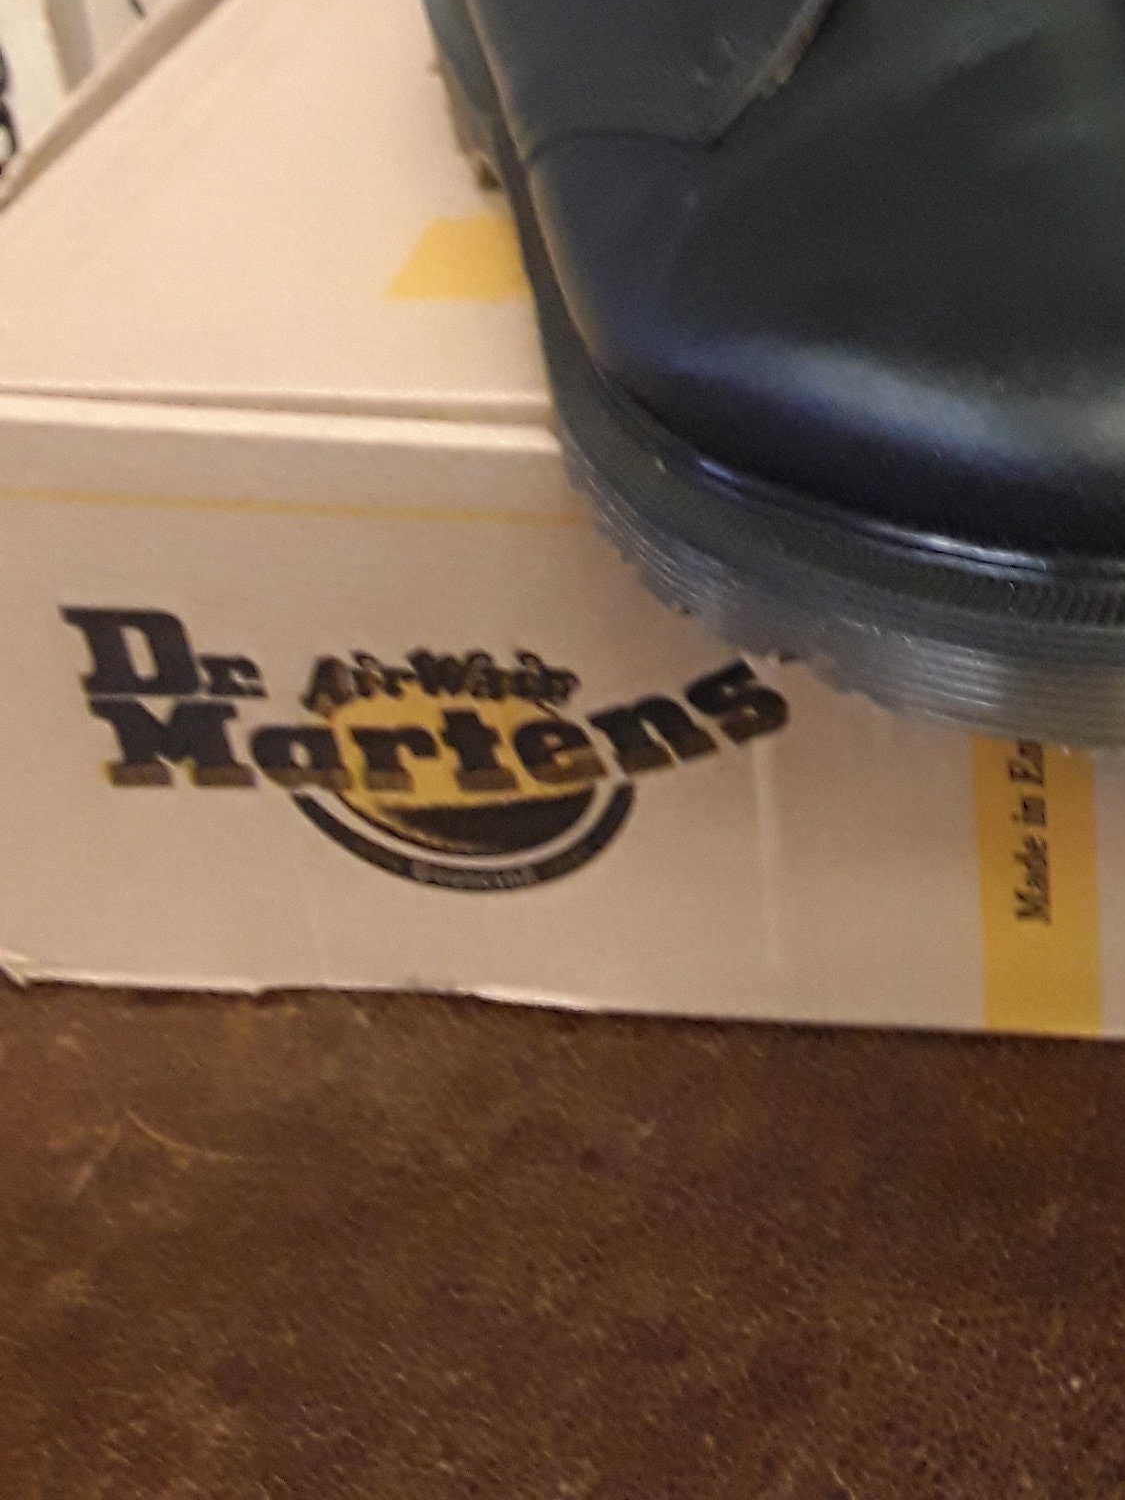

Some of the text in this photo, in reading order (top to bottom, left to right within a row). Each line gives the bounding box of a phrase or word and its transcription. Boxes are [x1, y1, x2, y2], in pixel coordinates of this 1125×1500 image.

[86, 658, 790, 790] Martens
[1012, 796, 1048, 828] in
[1014, 834, 1051, 927] Made
